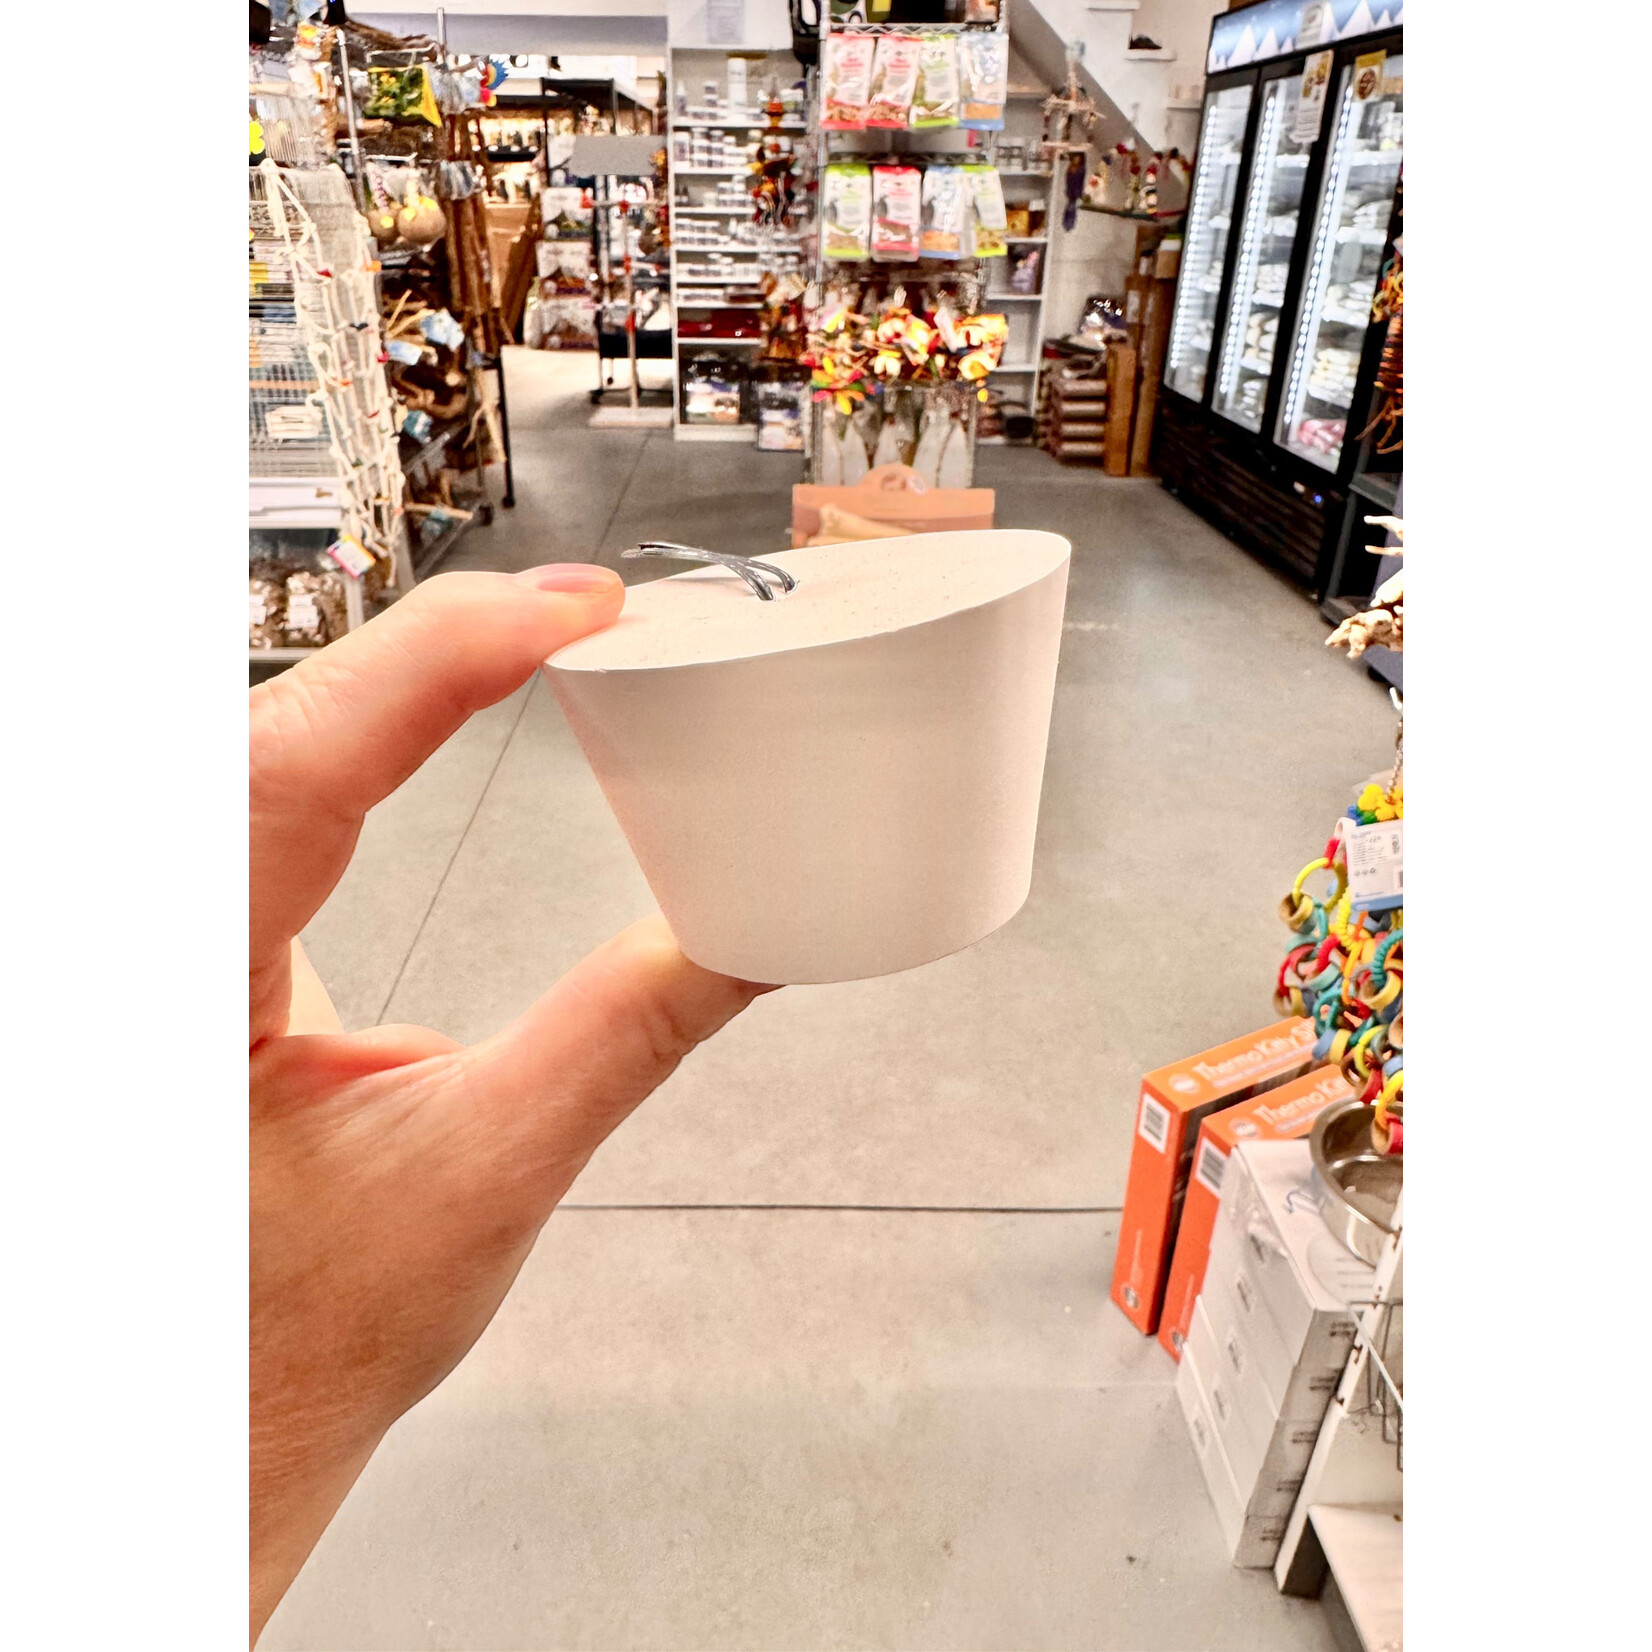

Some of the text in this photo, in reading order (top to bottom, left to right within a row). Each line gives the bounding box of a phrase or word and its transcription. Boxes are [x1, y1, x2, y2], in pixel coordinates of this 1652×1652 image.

[1192, 1049, 1263, 1081] Thermo
[1253, 1034, 1301, 1056] Kitty
[1252, 1090, 1326, 1125] Thermo
